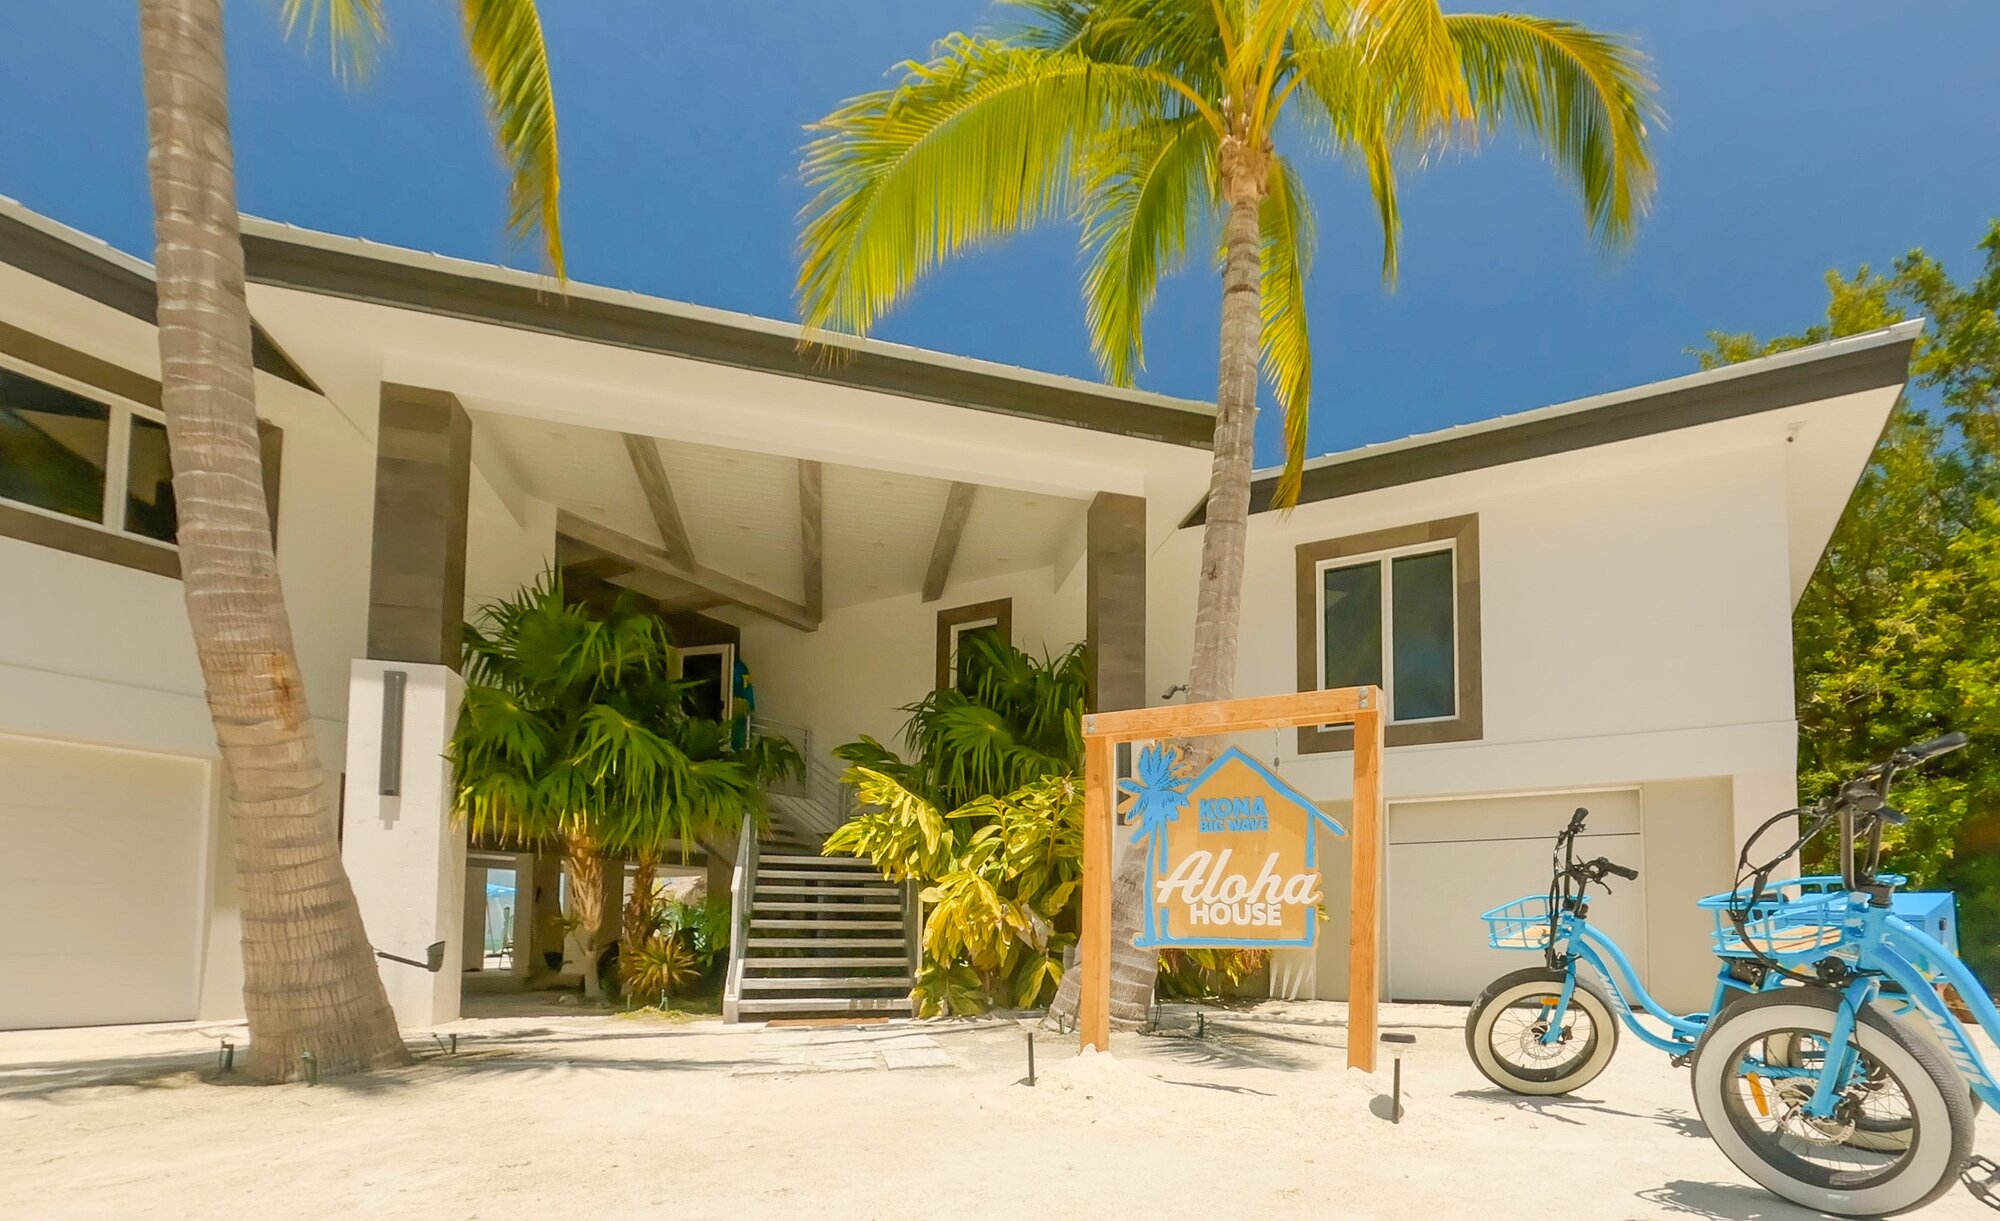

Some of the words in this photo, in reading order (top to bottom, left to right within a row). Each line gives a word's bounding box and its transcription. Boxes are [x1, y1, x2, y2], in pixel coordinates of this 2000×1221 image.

[1199, 796, 1268, 819] KONA
[1199, 819, 1225, 832] BIG
[1227, 818, 1269, 832] WAVE
[1156, 848, 1322, 905] Aloha
[1190, 902, 1282, 926] HOUSE
